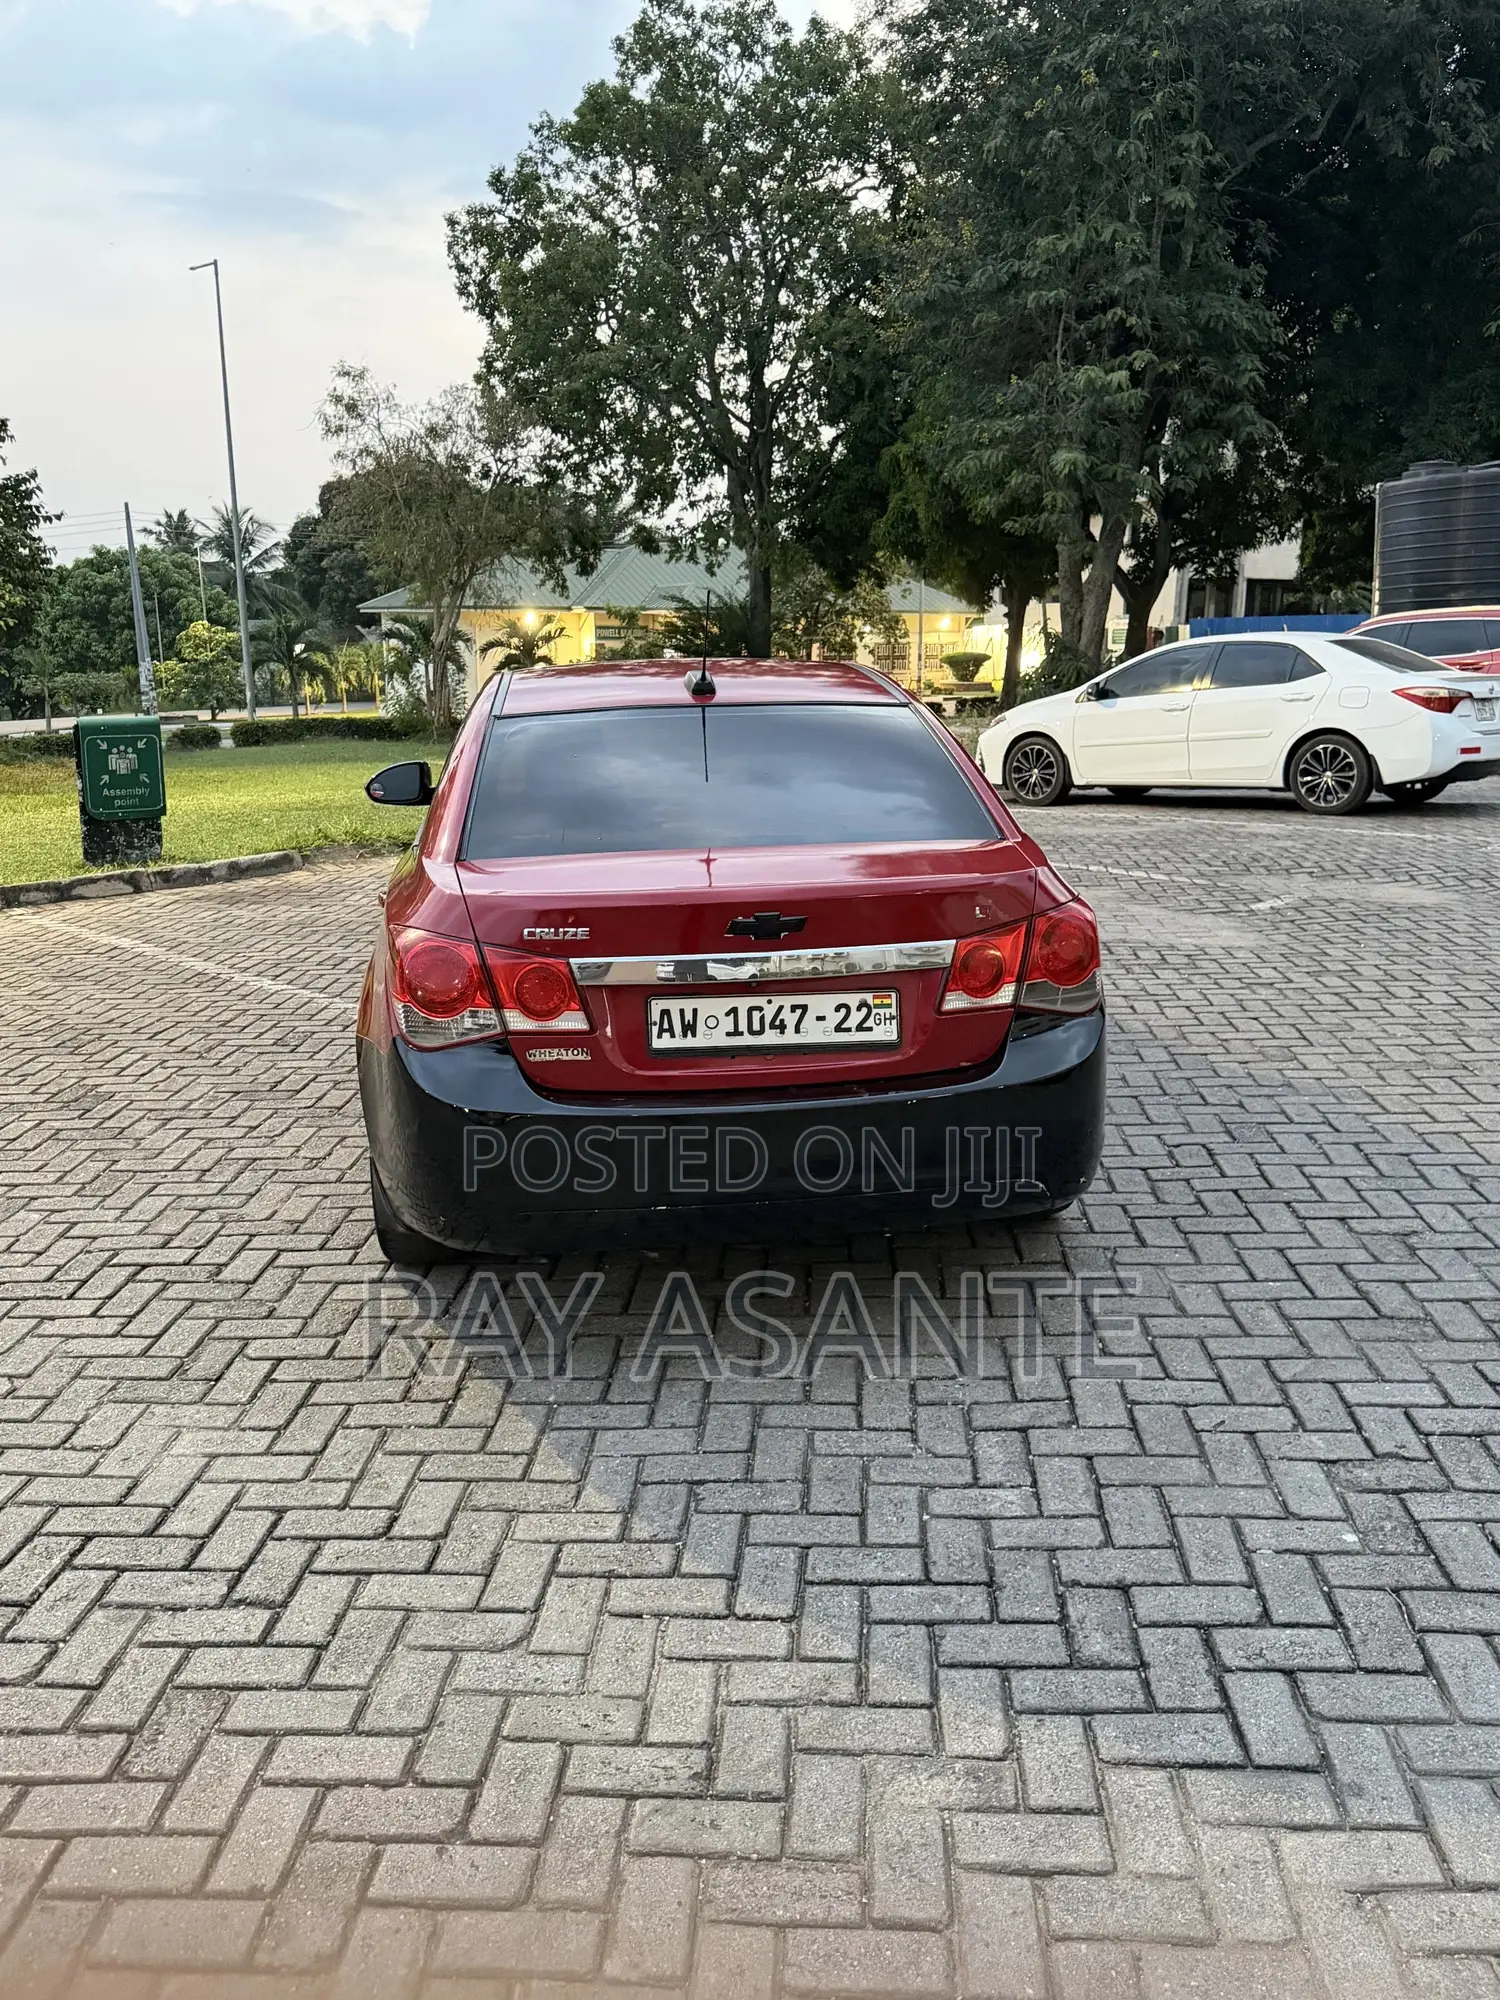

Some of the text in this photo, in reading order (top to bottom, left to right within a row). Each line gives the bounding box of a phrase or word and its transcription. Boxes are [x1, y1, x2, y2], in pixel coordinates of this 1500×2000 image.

[102, 787, 150, 797] Assembly
[114, 797, 140, 808] point
[523, 928, 590, 940] CRUZE
[656, 1008, 698, 1039] AW
[873, 1012, 892, 1026] GH
[527, 1048, 589, 1059] WHEATON
